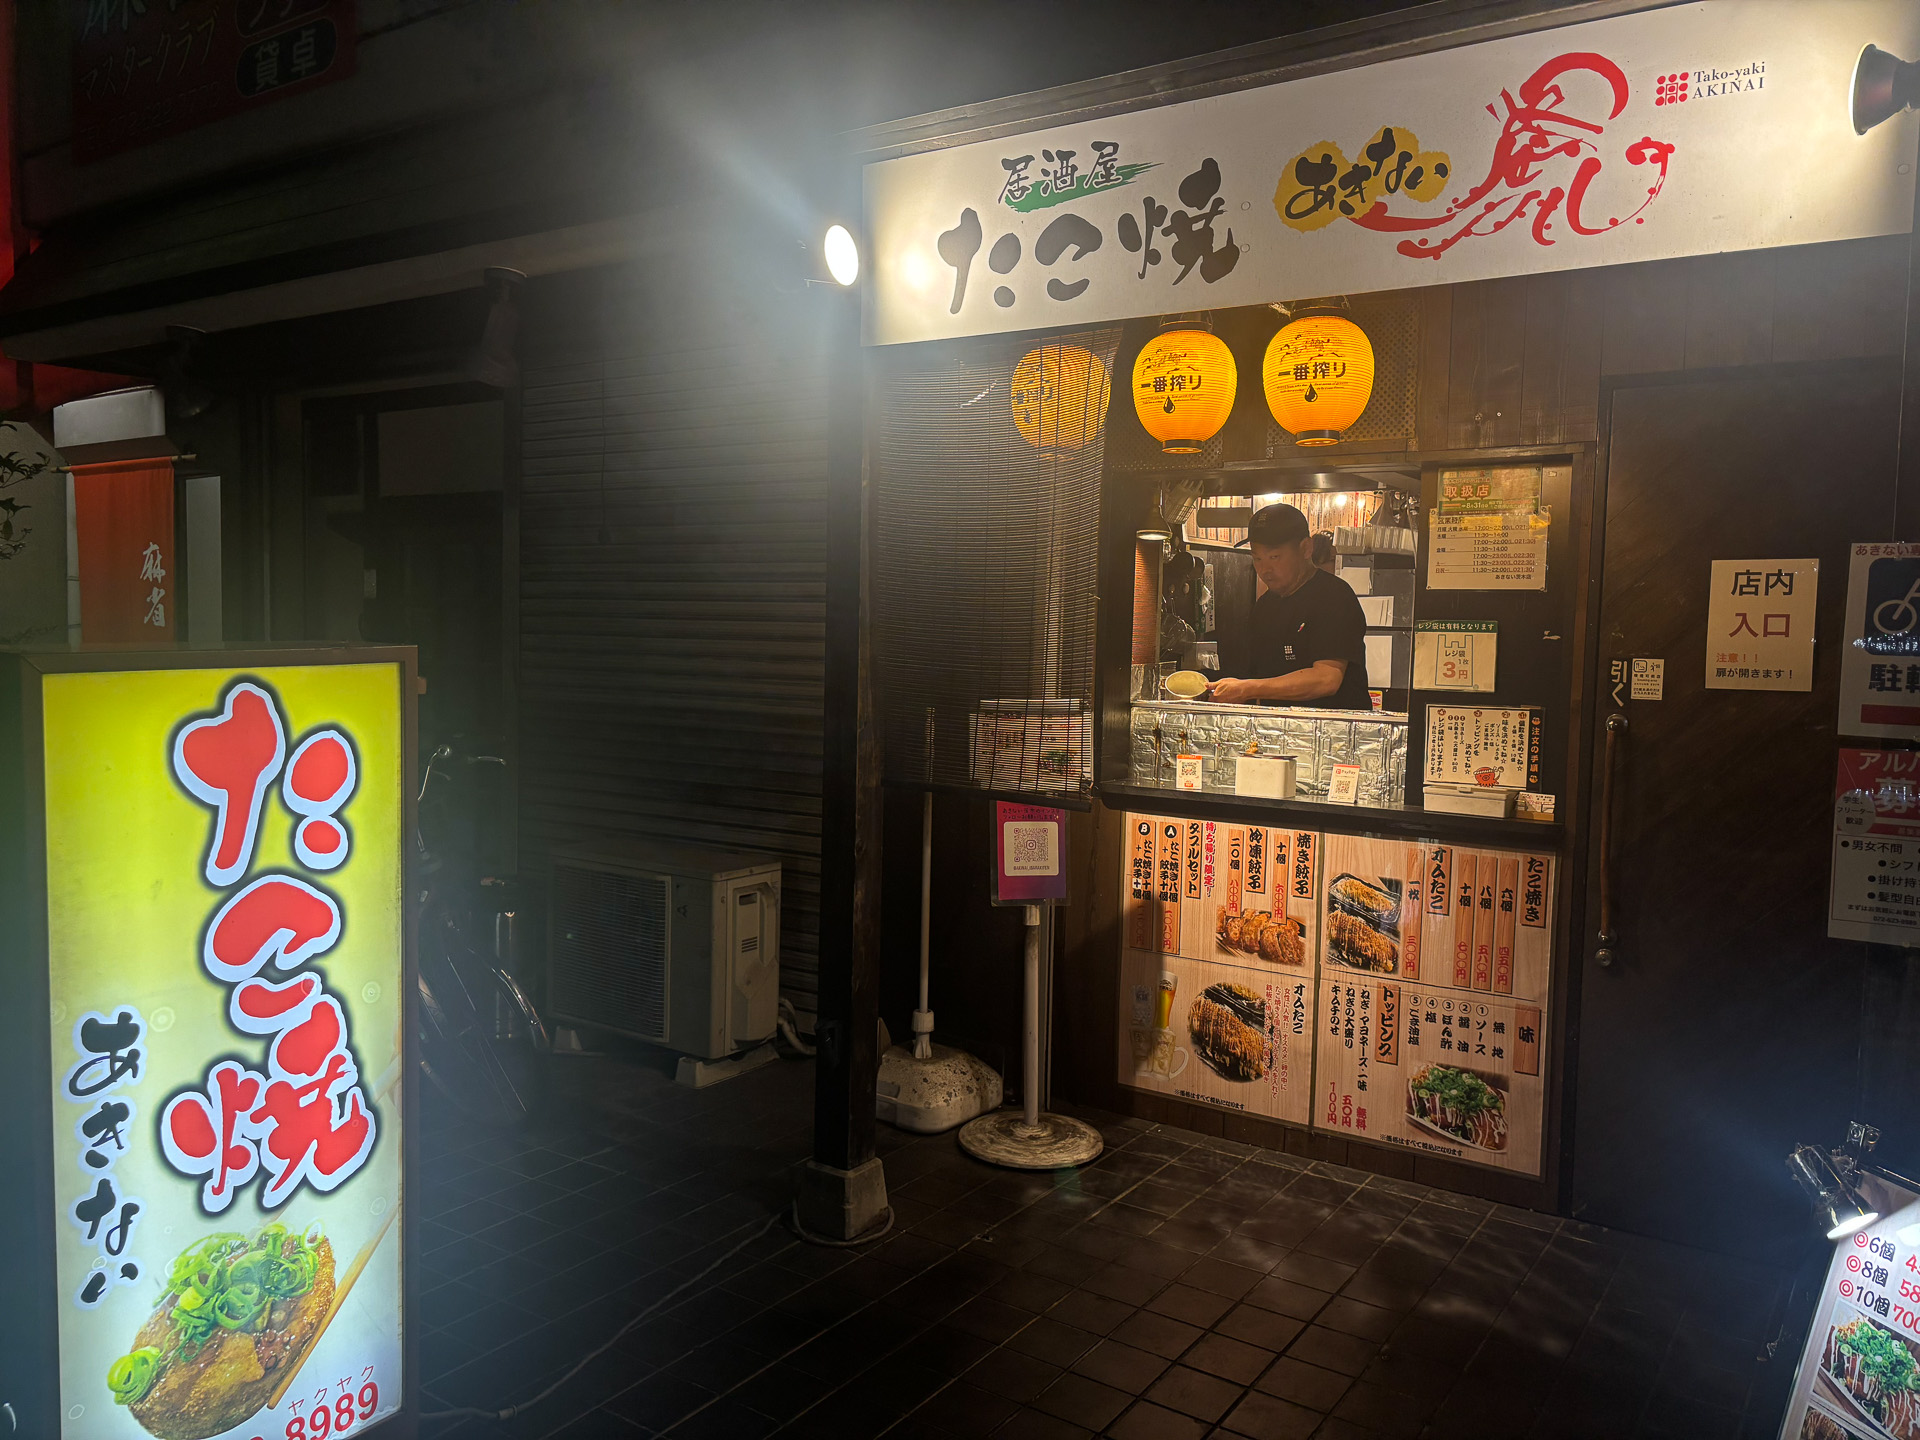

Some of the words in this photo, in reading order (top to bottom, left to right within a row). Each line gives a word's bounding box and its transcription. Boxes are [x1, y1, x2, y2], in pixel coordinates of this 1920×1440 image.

[1693, 61, 1766, 84] Tako-yaki
[1691, 76, 1765, 100] AKINAI
[998, 140, 1121, 204] 居酒屋
[1284, 127, 1449, 219] あきない
[937, 157, 1240, 315] たこ焼
[1140, 374, 1202, 393] 一番搾り
[1278, 361, 1347, 381] 一番搾り
[1731, 569, 1794, 597] 店内
[1418, 622, 1495, 631] レジ袋は有料となります
[1729, 612, 1791, 638] 入口
[1445, 650, 1466, 658] レジ袋
[1443, 661, 1456, 678] 3
[1458, 669, 1468, 679] 円
[1610, 660, 1628, 707] 引く
[1247, 827, 1264, 890] 冷凍餃子
[1852, 841, 1902, 854] 男女不問
[1294, 832, 1312, 895] 焼き餃子
[1889, 860, 1920, 872] シフ
[1430, 847, 1447, 910] オムたこ
[1524, 857, 1544, 922] たこ焼き
[1878, 875, 1920, 893] 掛け持
[1459, 882, 1472, 907] 十個
[1479, 885, 1492, 910] 八個
[1501, 888, 1514, 912] 六個
[1291, 983, 1306, 1035] オムたこ
[1378, 985, 1395, 1057] トッピング
[1518, 1025, 1535, 1044] 味
[69, 1011, 141, 1304] あきない
[1869, 1236, 1897, 1263] 6個
[1905, 1253, 1920, 1275] 4
[1861, 1260, 1890, 1288] 8個
[1857, 1285, 1891, 1318] 10個
[288, 1365, 375, 1417] ヤクヤク
